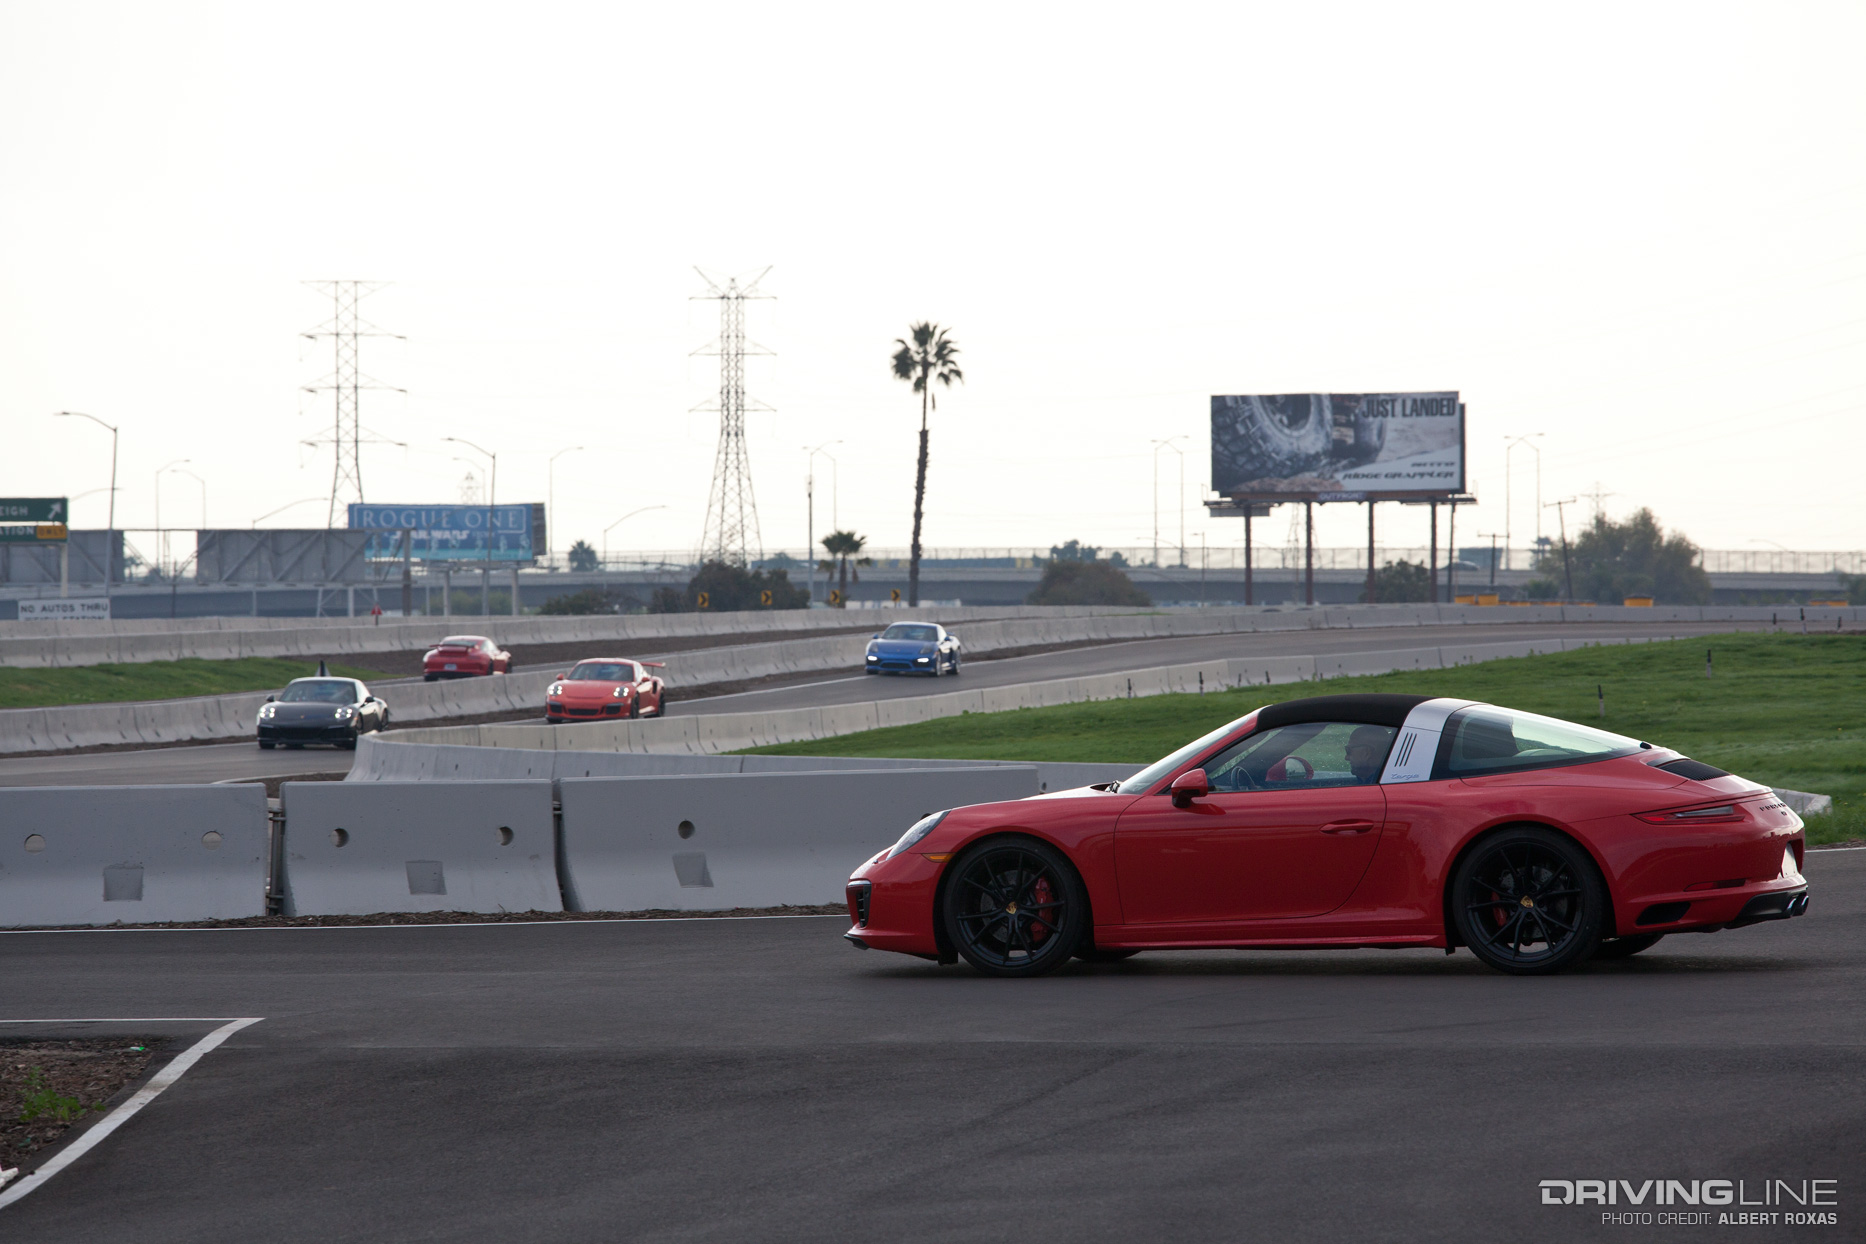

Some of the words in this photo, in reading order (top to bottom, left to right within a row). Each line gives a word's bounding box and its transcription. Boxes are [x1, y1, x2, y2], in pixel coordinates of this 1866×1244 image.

[1362, 398, 1397, 418] JUST
[1402, 397, 1456, 417] LANDED
[1343, 472, 1382, 480] RIDGE
[1384, 471, 1455, 479] GRAPPLER
[363, 509, 452, 529] ROGUE
[465, 510, 519, 529] ONE
[40, 528, 65, 537] ONLY
[431, 530, 470, 539] WARS
[20, 605, 35, 613] NO
[41, 604, 76, 613] AUTOS
[81, 603, 108, 612] THRU
